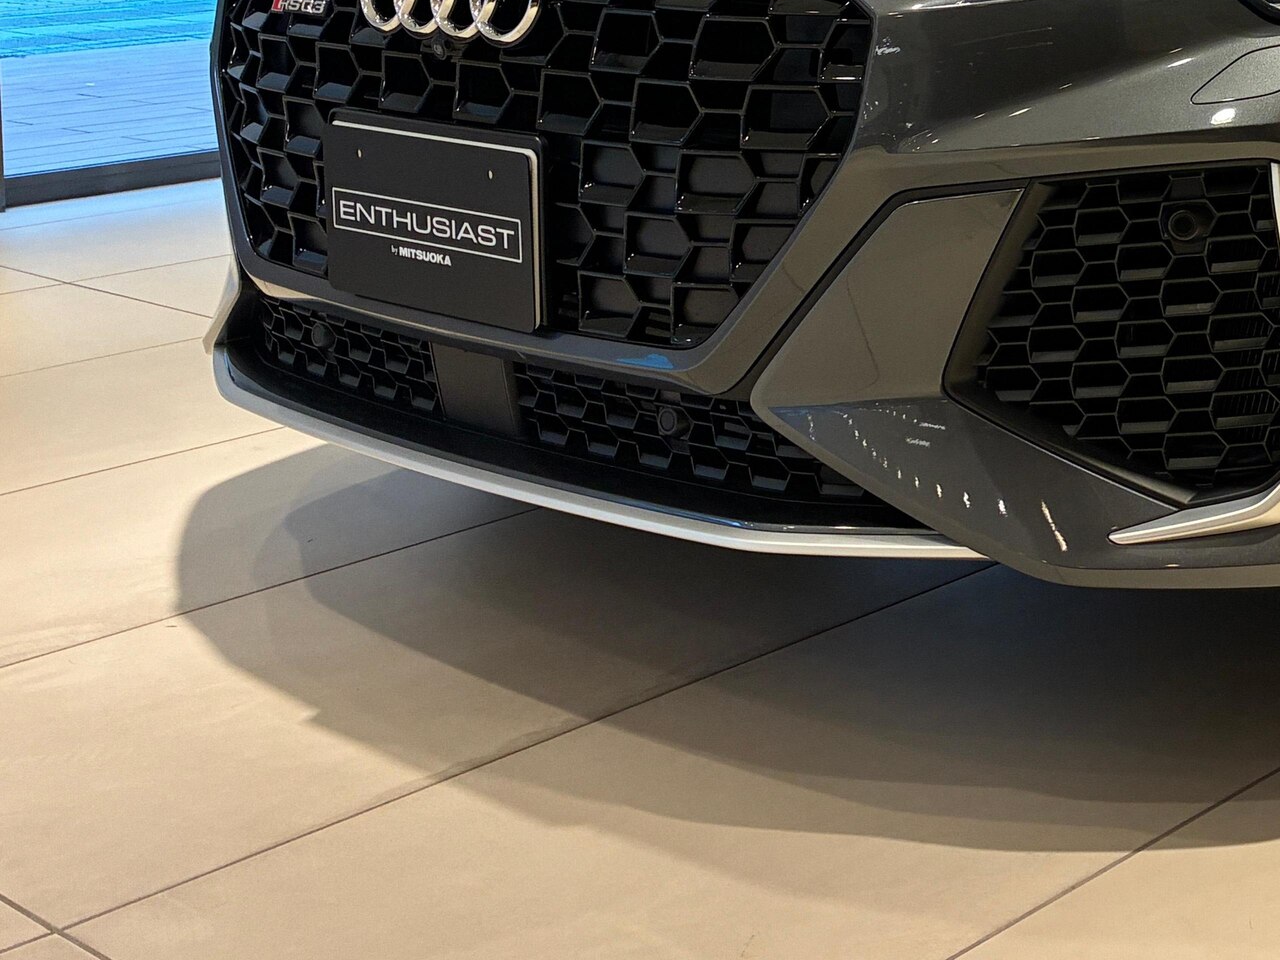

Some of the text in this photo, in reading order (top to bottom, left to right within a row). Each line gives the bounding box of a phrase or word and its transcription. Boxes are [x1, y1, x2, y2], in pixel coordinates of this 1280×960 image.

[339, 199, 515, 249] ENTHUSIAST
[391, 245, 452, 266] by MITSUOKA
